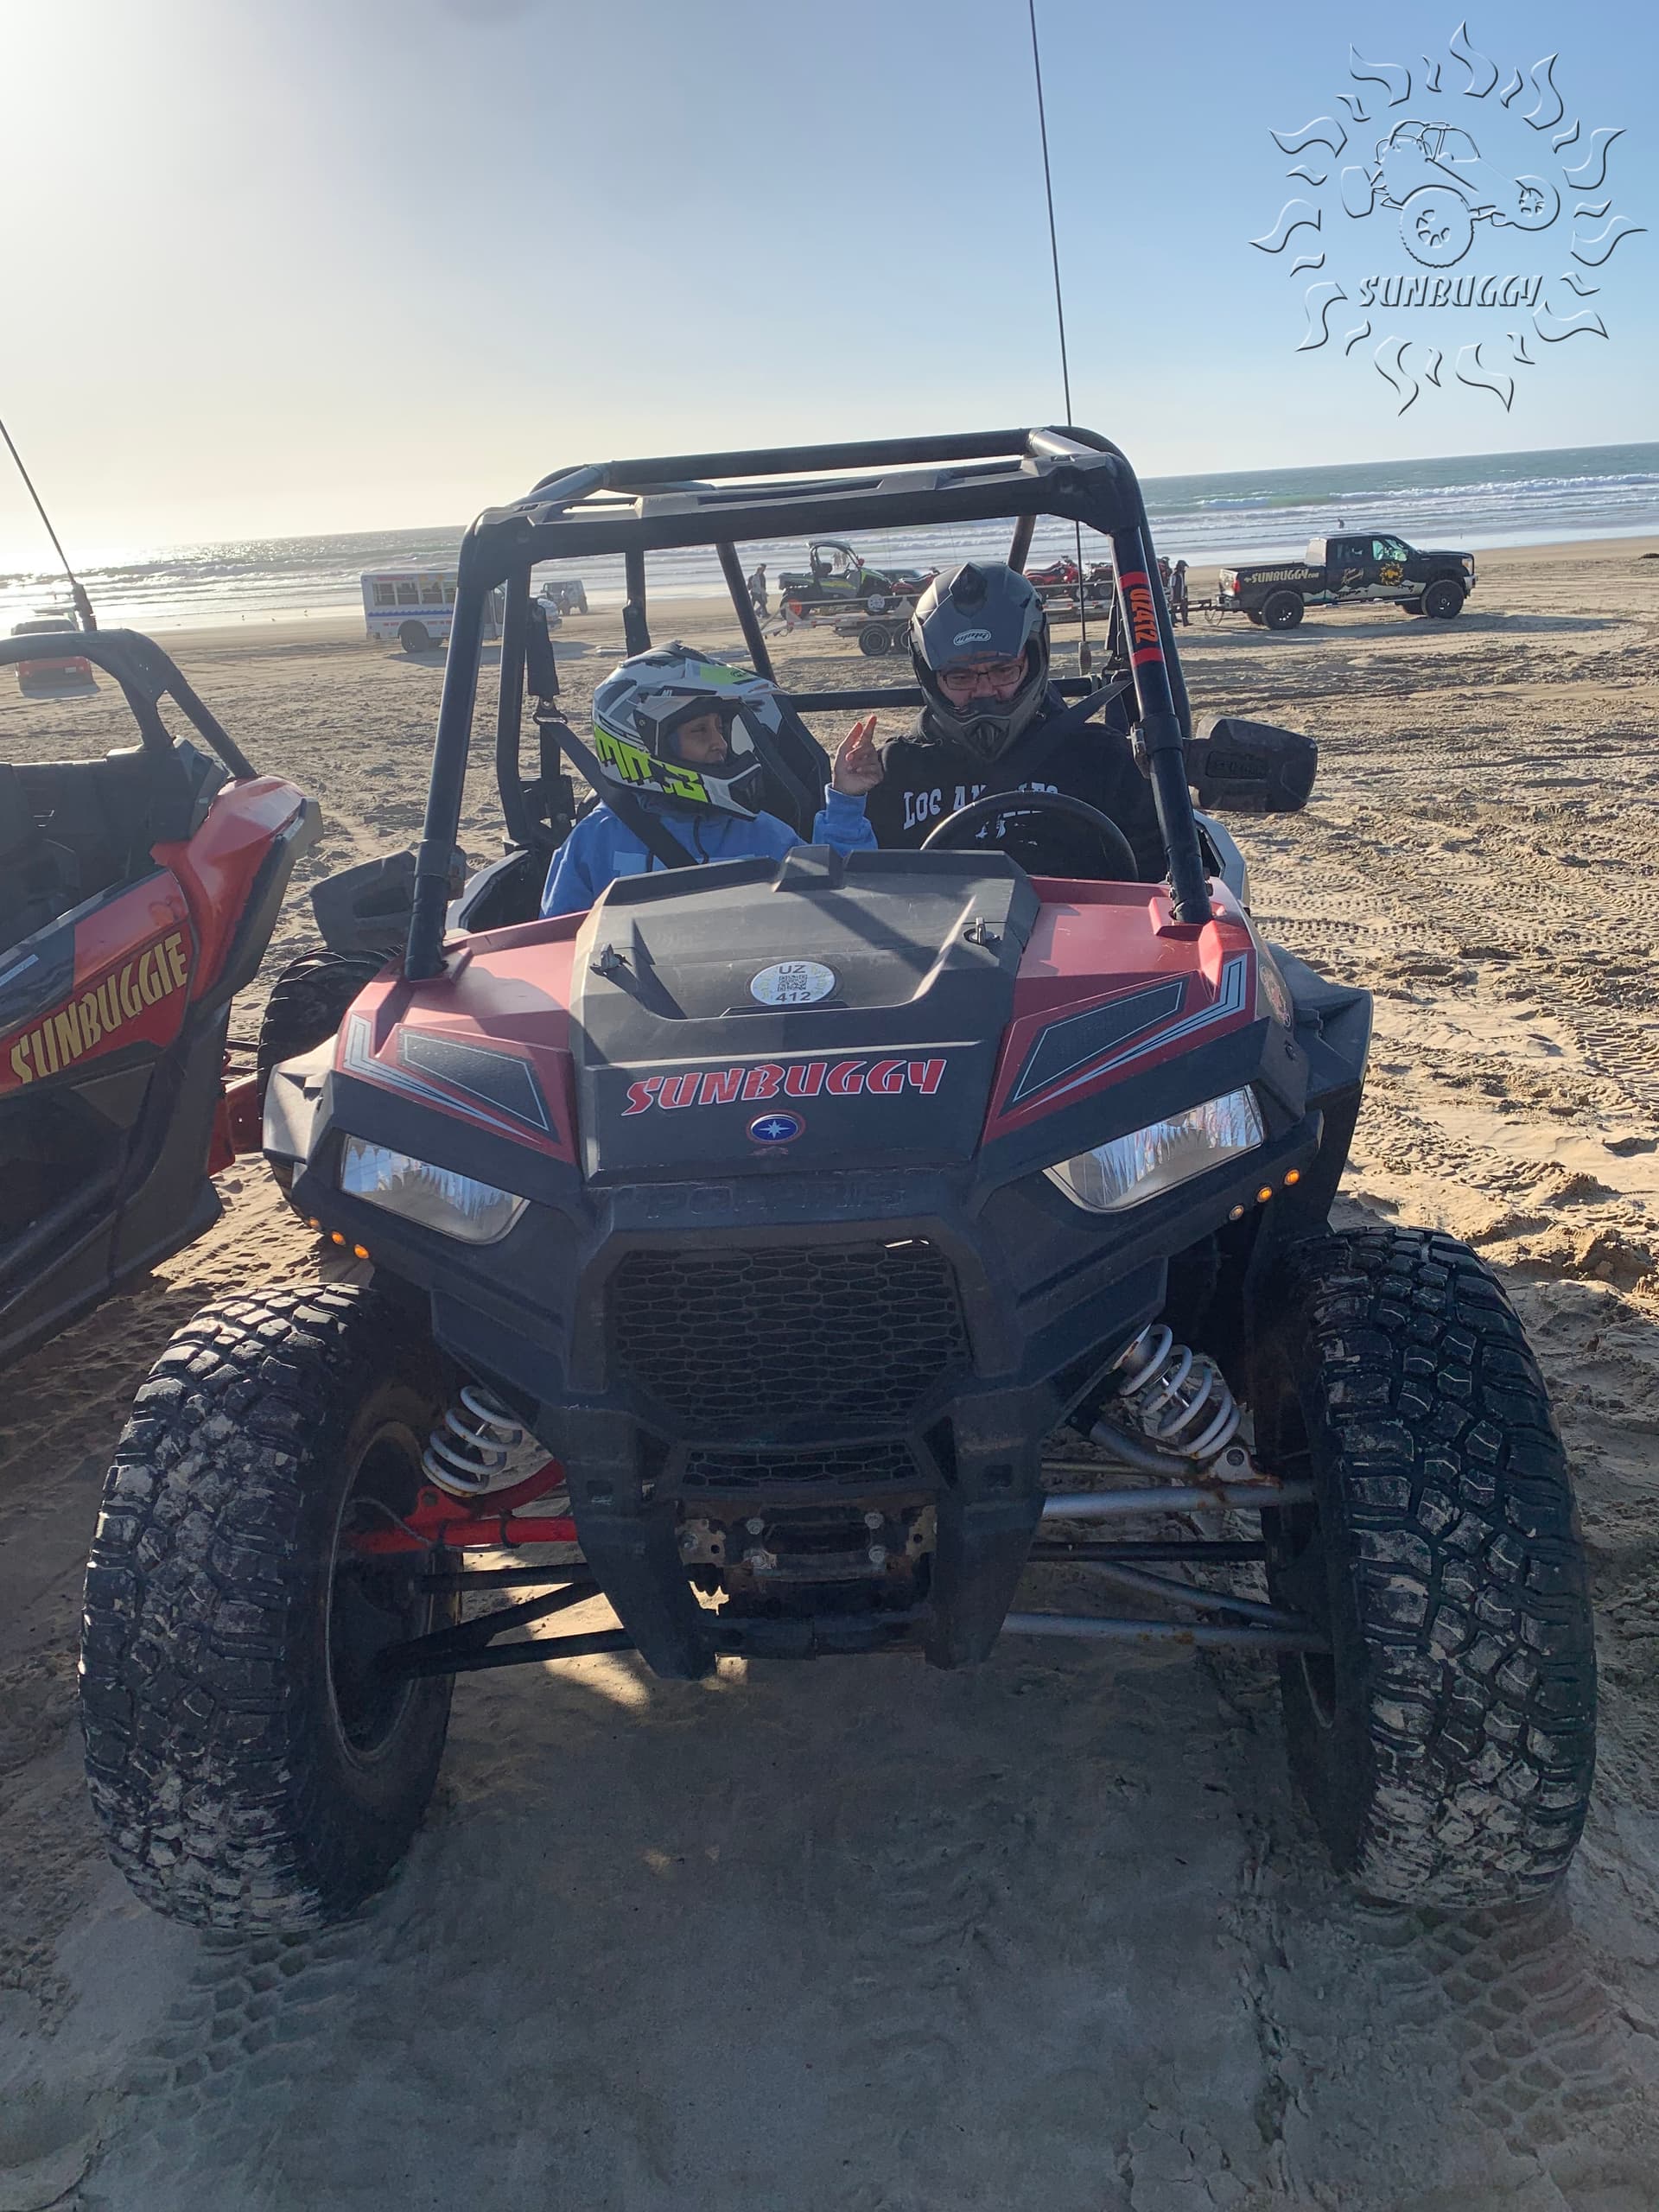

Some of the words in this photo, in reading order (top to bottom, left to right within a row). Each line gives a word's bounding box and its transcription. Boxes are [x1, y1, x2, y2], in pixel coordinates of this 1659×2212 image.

[1129, 588, 1158, 644] UZ412
[776, 992, 810, 1001] 412
[779, 964, 806, 974] UZ
[10, 931, 188, 1084] SUNBUGGIE
[620, 1059, 947, 1116] SUNBUGGY
